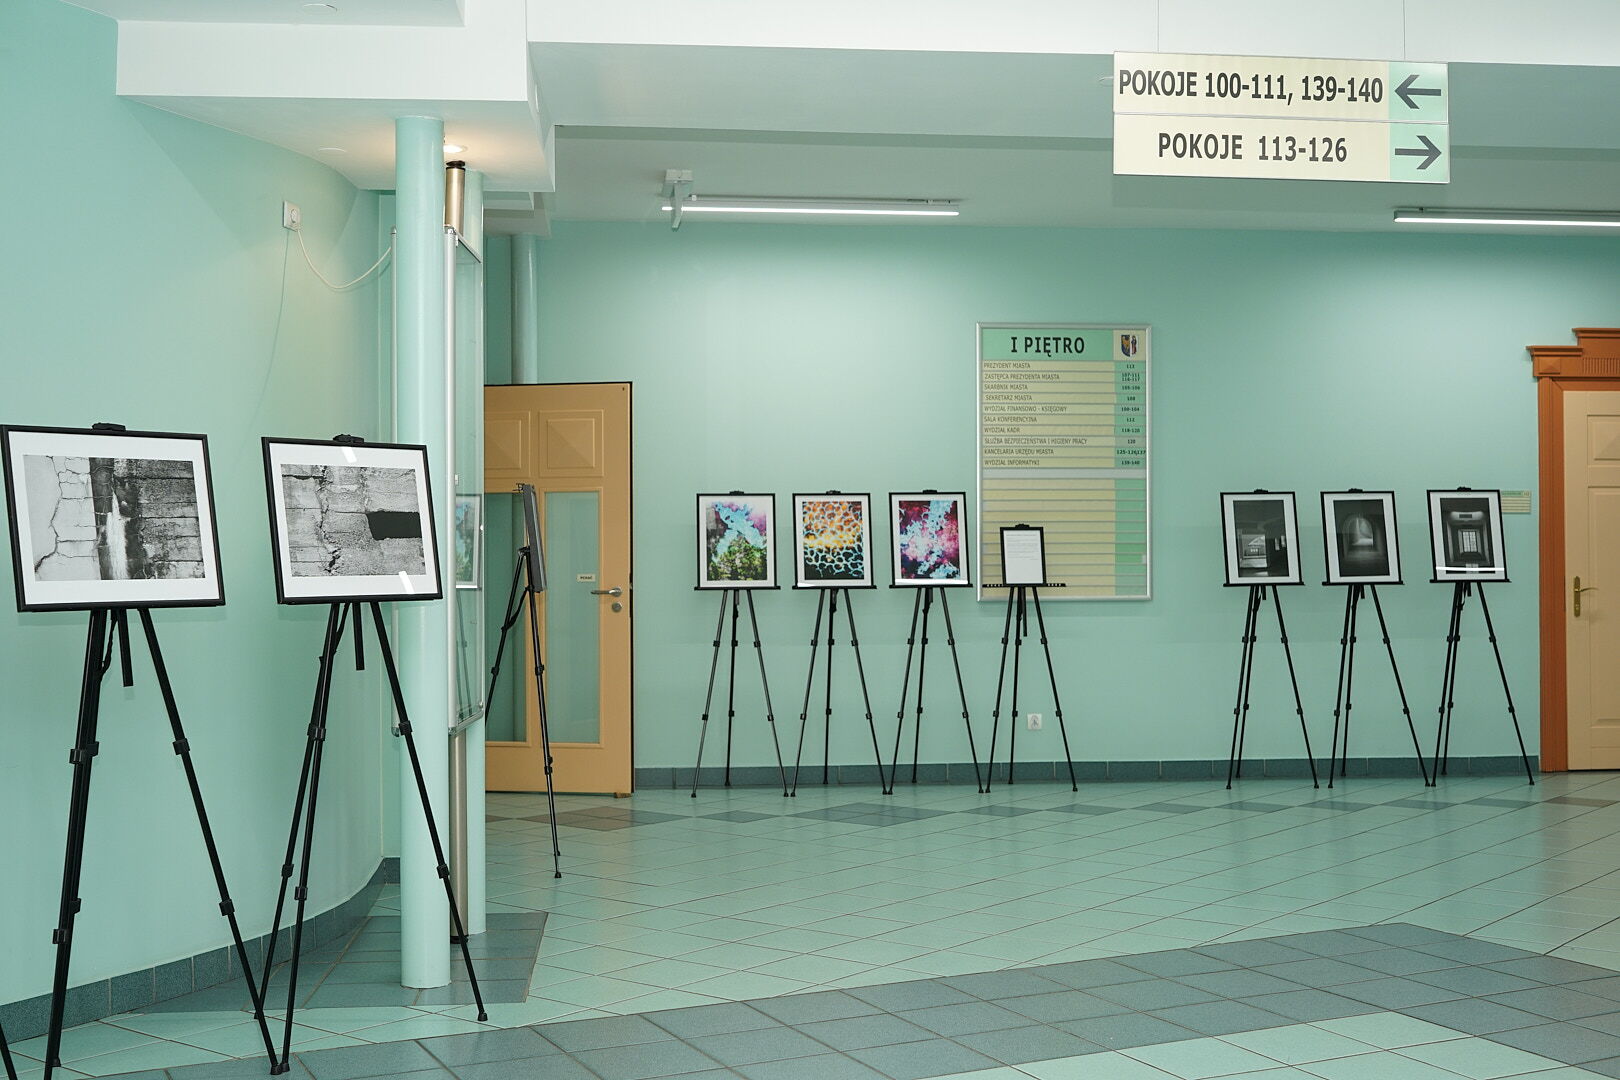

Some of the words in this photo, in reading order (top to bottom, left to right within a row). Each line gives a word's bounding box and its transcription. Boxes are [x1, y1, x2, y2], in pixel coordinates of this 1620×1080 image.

[1119, 69, 1197, 96] POKOJE
[1206, 72, 1293, 105] 100-111,
[1302, 76, 1383, 103] 139-140
[1158, 132, 1243, 160] POKOJE
[1259, 136, 1347, 162] 113-126
[1011, 337, 1018, 353] I
[1024, 337, 1085, 357] PIĘTRO
